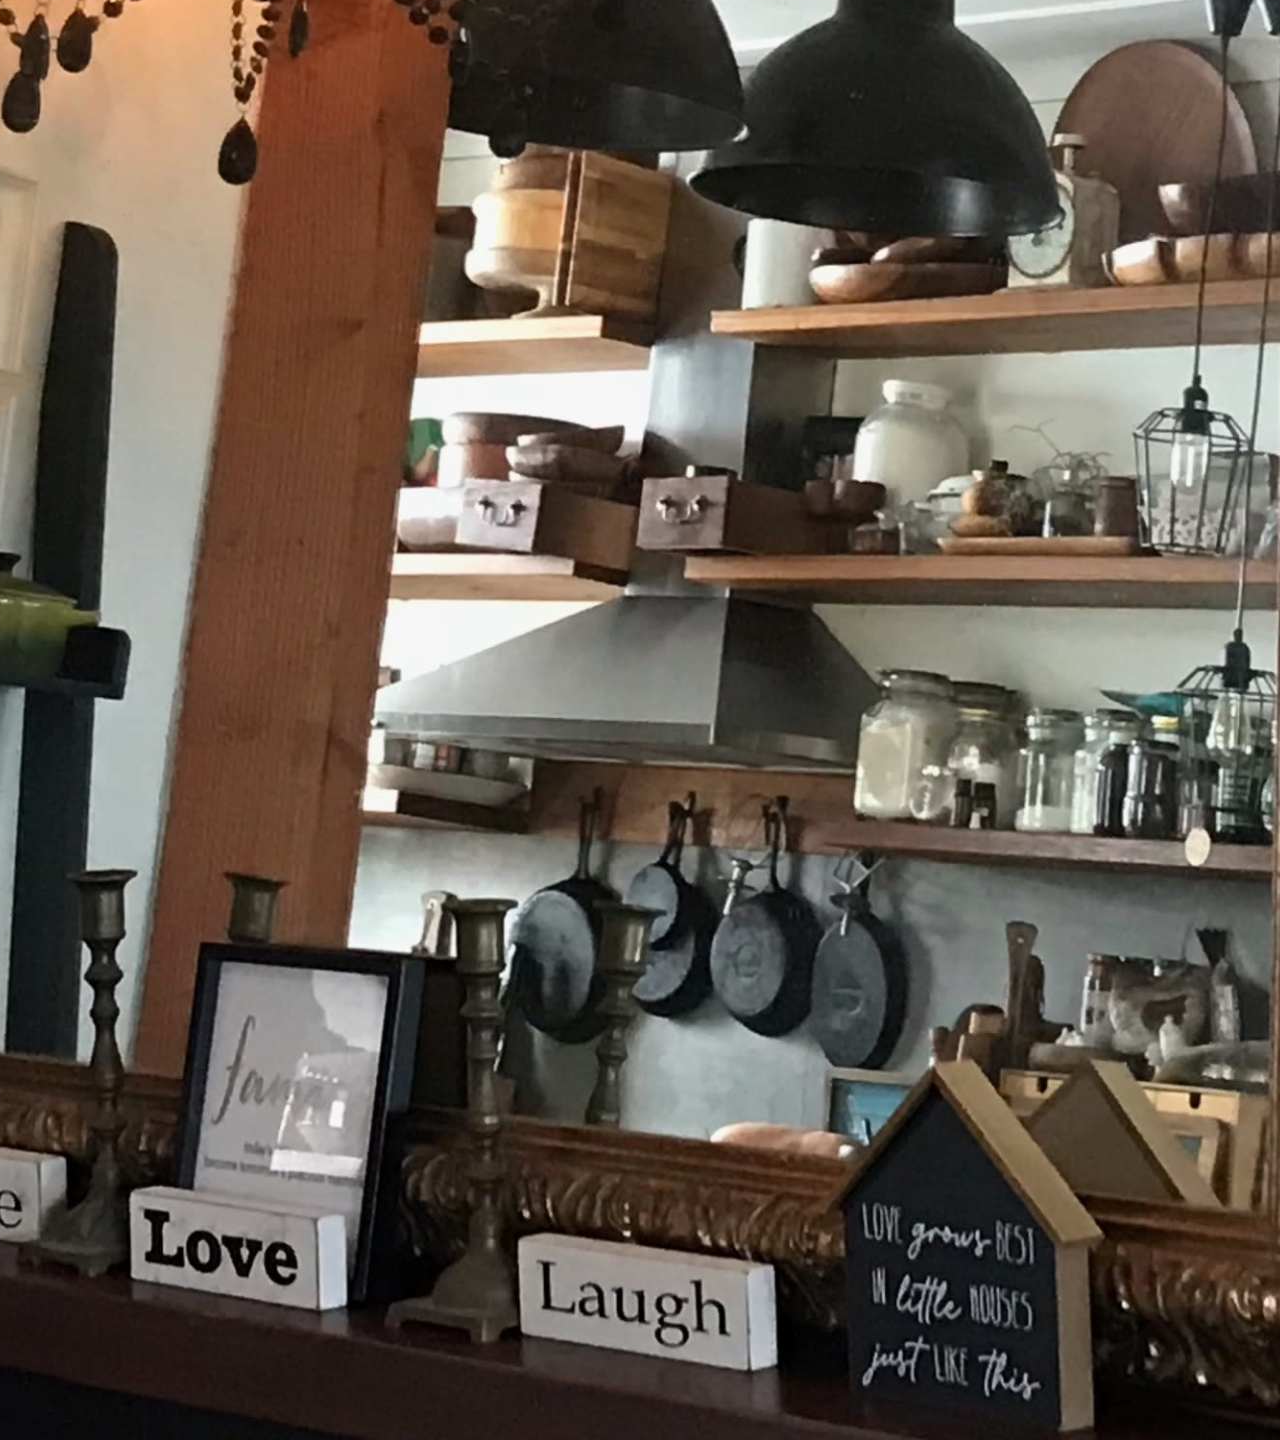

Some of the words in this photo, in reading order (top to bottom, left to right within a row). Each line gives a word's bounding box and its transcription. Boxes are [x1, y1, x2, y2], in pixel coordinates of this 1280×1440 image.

[143, 1208, 298, 1286] Love
[862, 1202, 903, 1245] LOVE
[907, 1222, 991, 1260] grows
[995, 1220, 1035, 1265] BEST
[536, 1259, 731, 1348] Laugh
[871, 1267, 886, 1305] IN
[896, 1273, 962, 1325] little
[969, 1283, 1033, 1331] HOUSES
[861, 1336, 931, 1387] just
[932, 1343, 969, 1387] LIKE
[977, 1348, 1042, 1401] this
